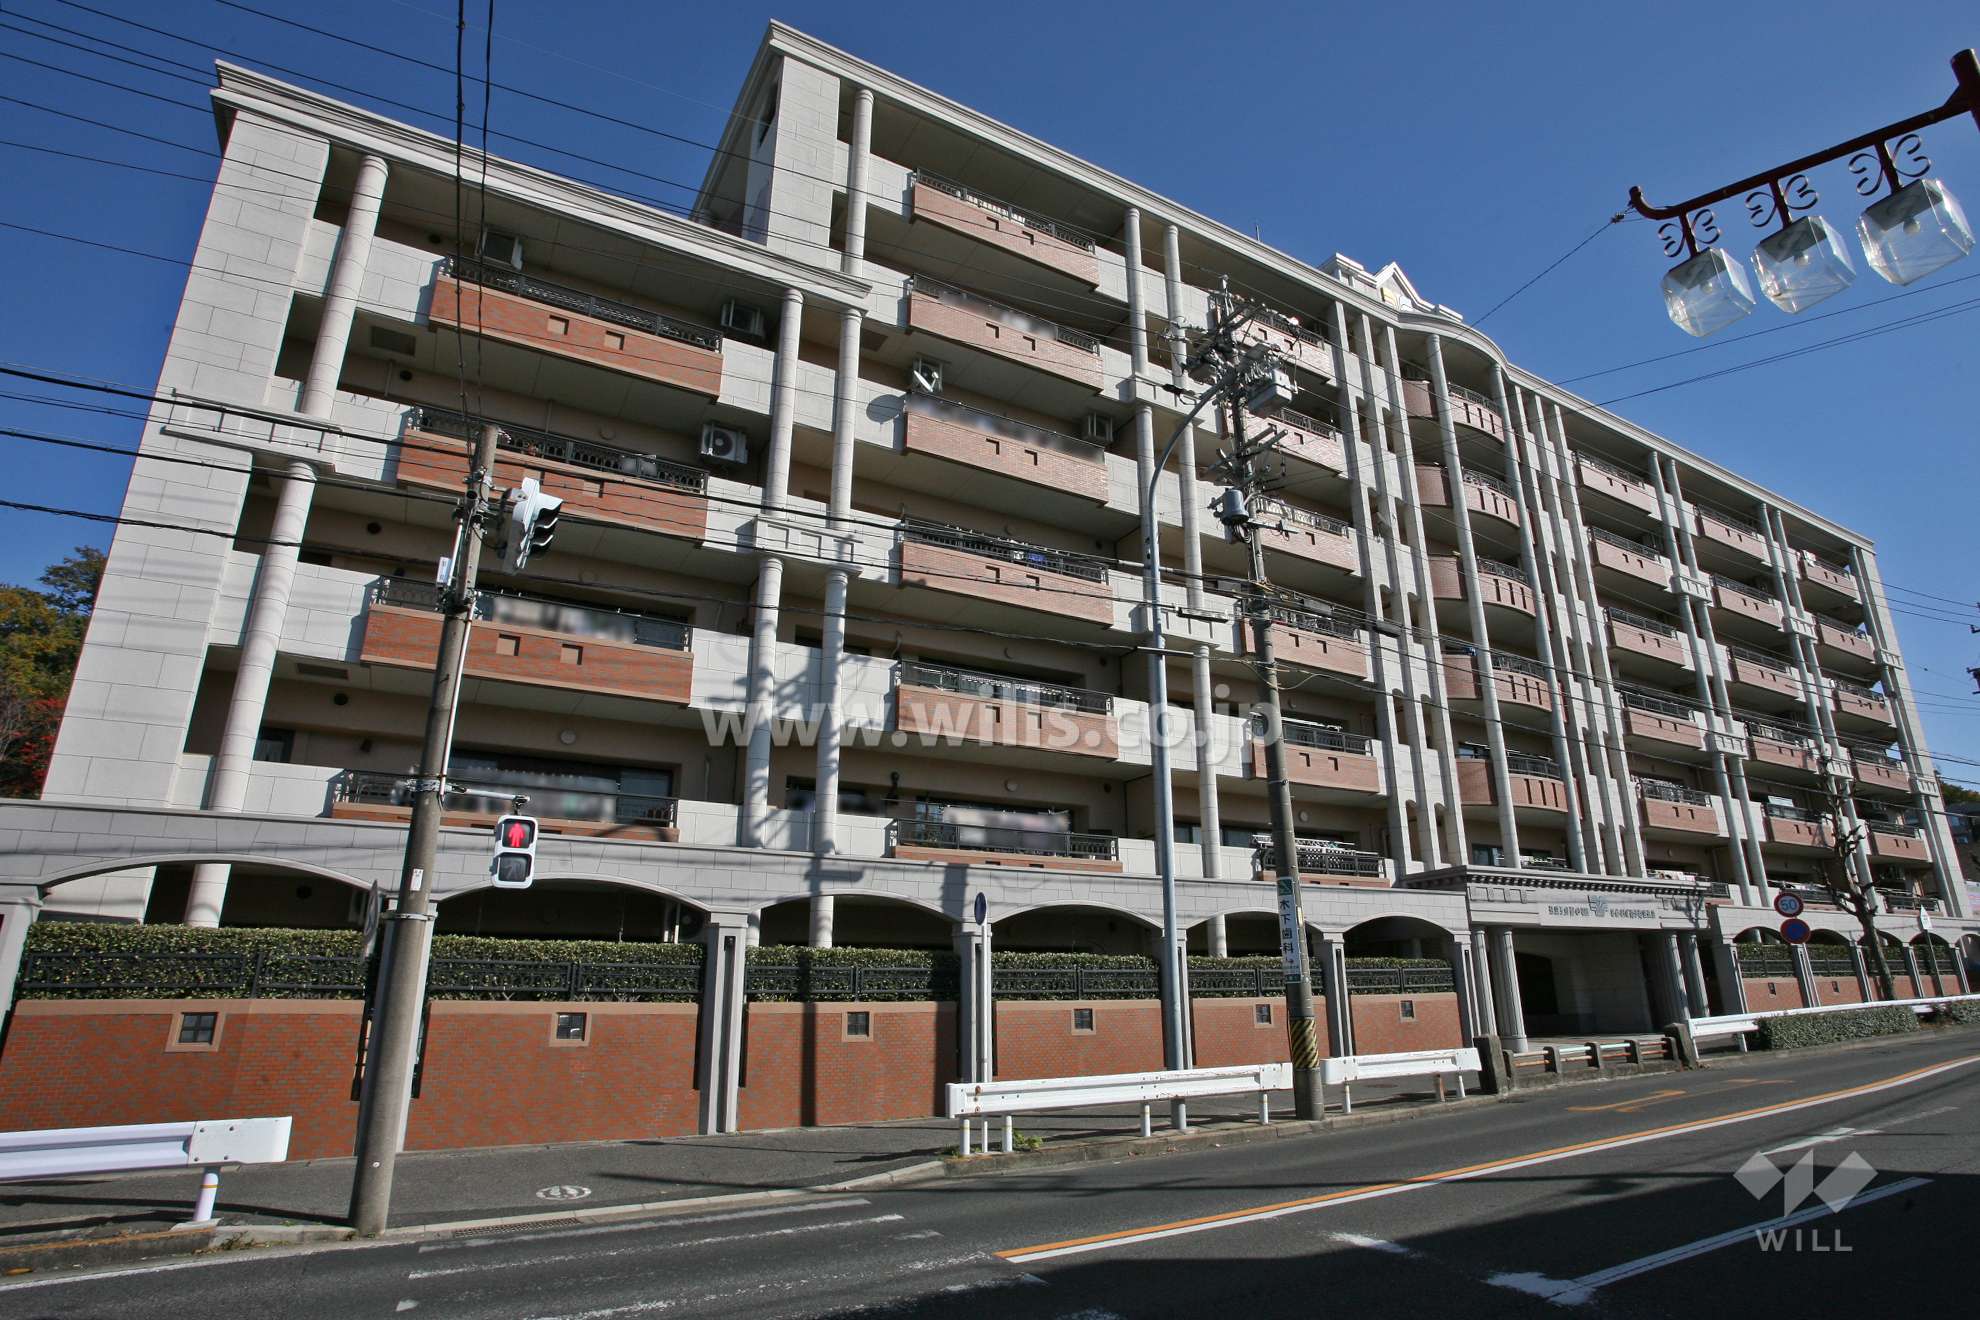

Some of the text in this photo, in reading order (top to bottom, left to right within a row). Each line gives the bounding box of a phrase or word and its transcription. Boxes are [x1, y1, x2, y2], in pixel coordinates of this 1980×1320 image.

[1781, 899, 1797, 911] 50
[1280, 901, 1294, 953] 木下歯科
